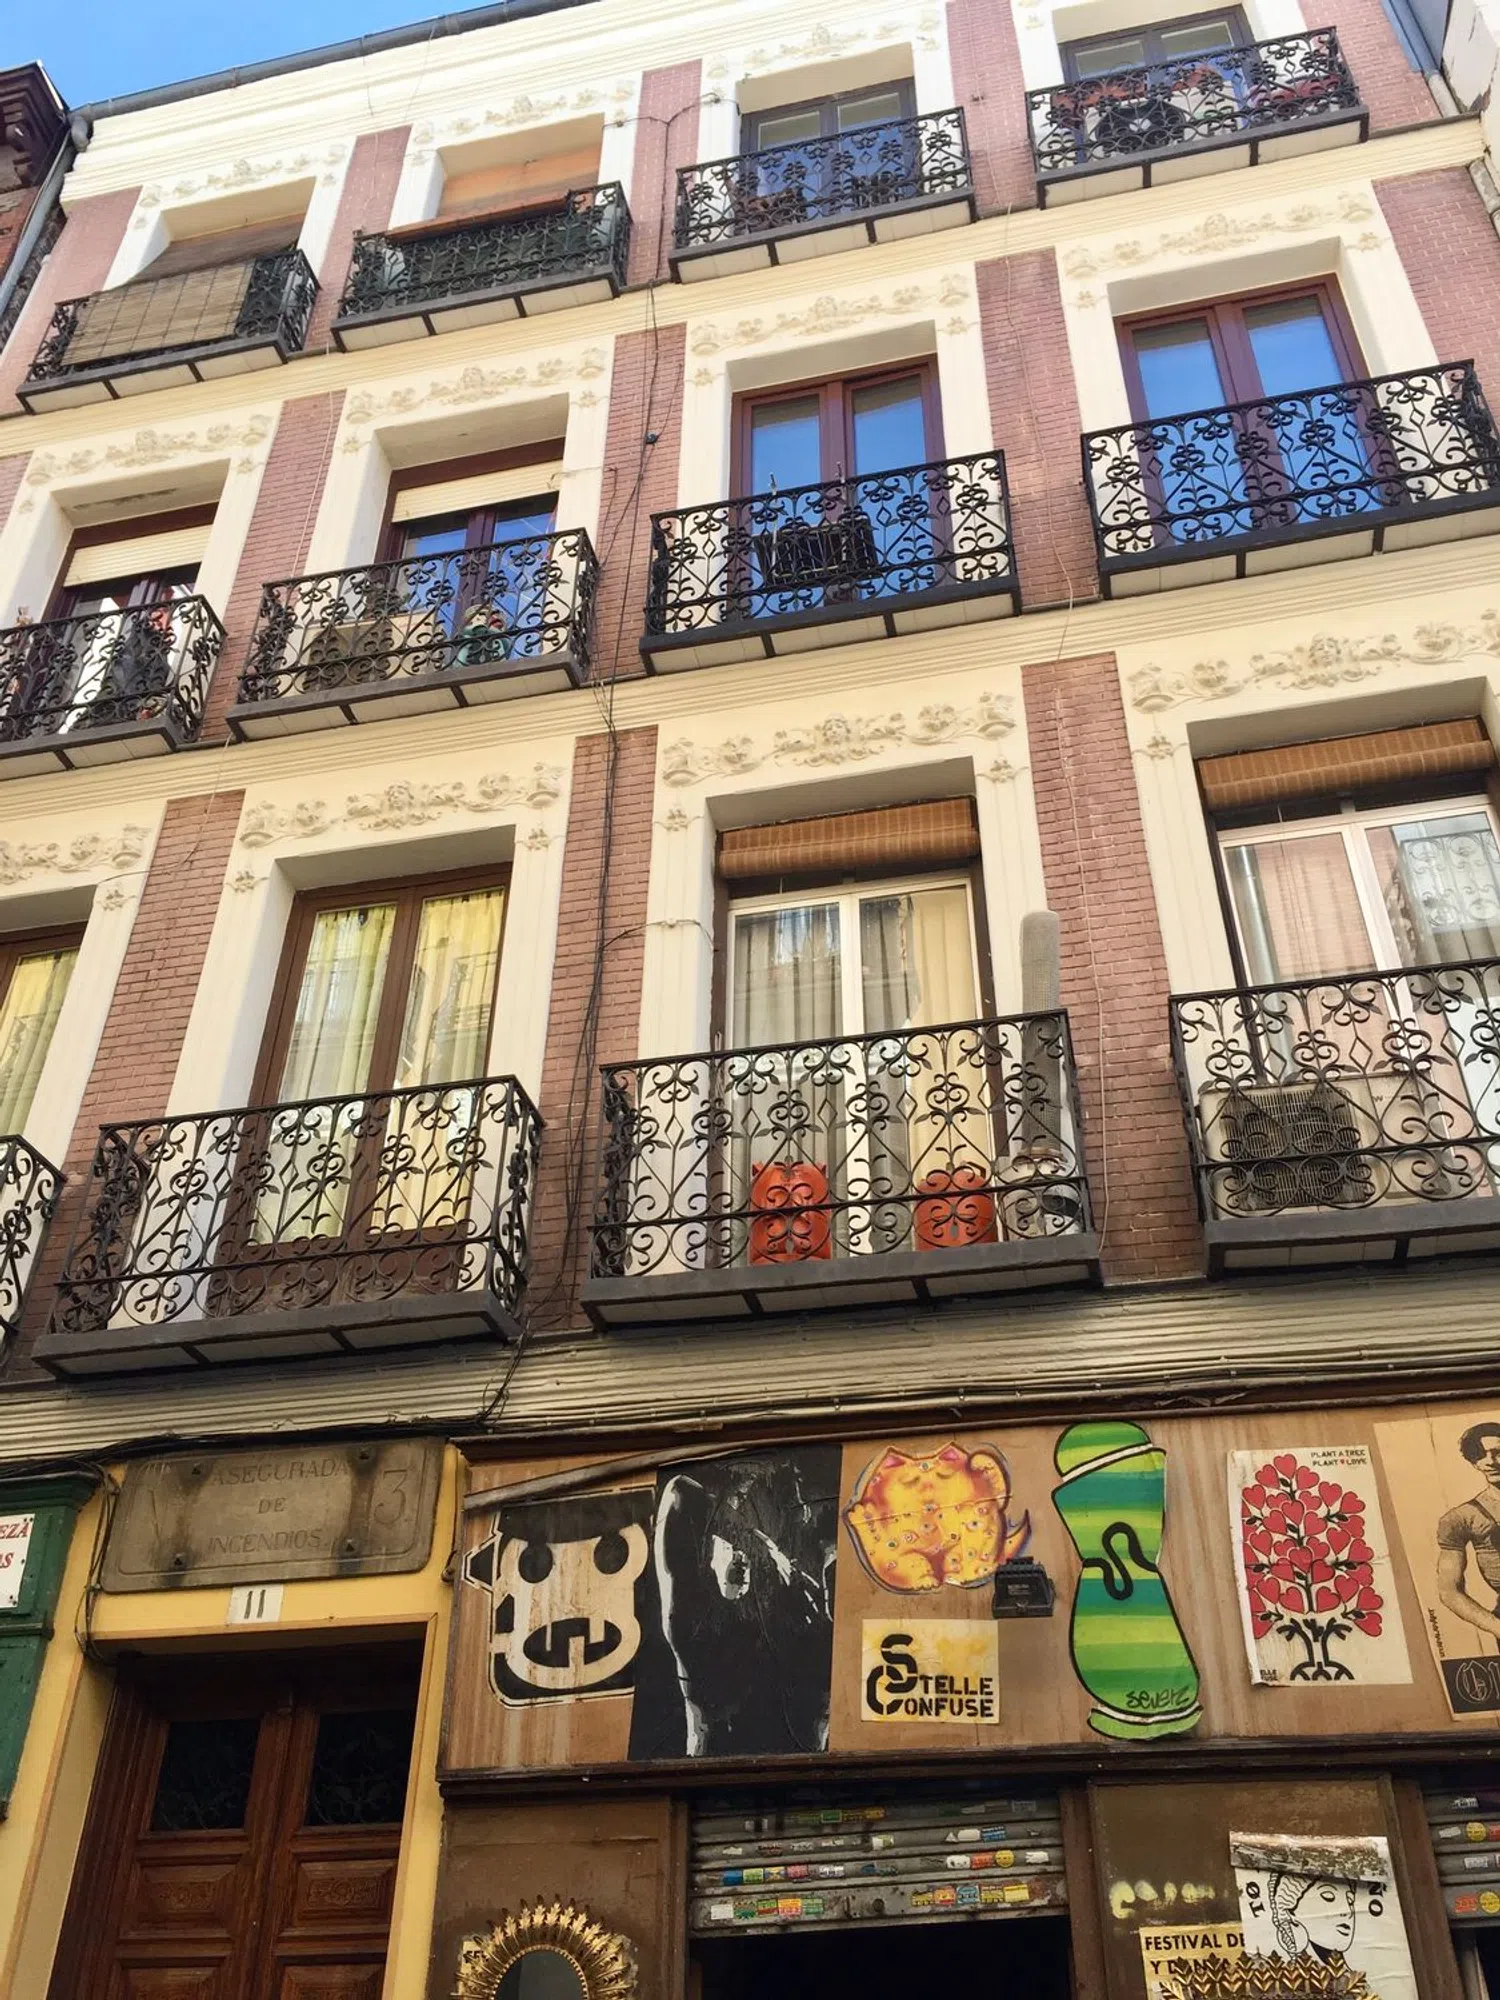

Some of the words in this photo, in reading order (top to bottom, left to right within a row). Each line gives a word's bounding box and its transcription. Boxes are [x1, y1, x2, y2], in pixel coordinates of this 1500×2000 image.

[1310, 1450, 1337, 1458] PLANT
[1312, 1459, 1338, 1467] PLANT
[210, 1458, 348, 1486] ASEGURADA
[258, 1497, 286, 1515] DE
[244, 1589, 266, 1620] 11
[881, 1634, 994, 1696] STELLE
[866, 1665, 994, 1717] CONFUSE
[1144, 1933, 1222, 1951] FESTIVAL
[1150, 1960, 1161, 1975] Y
